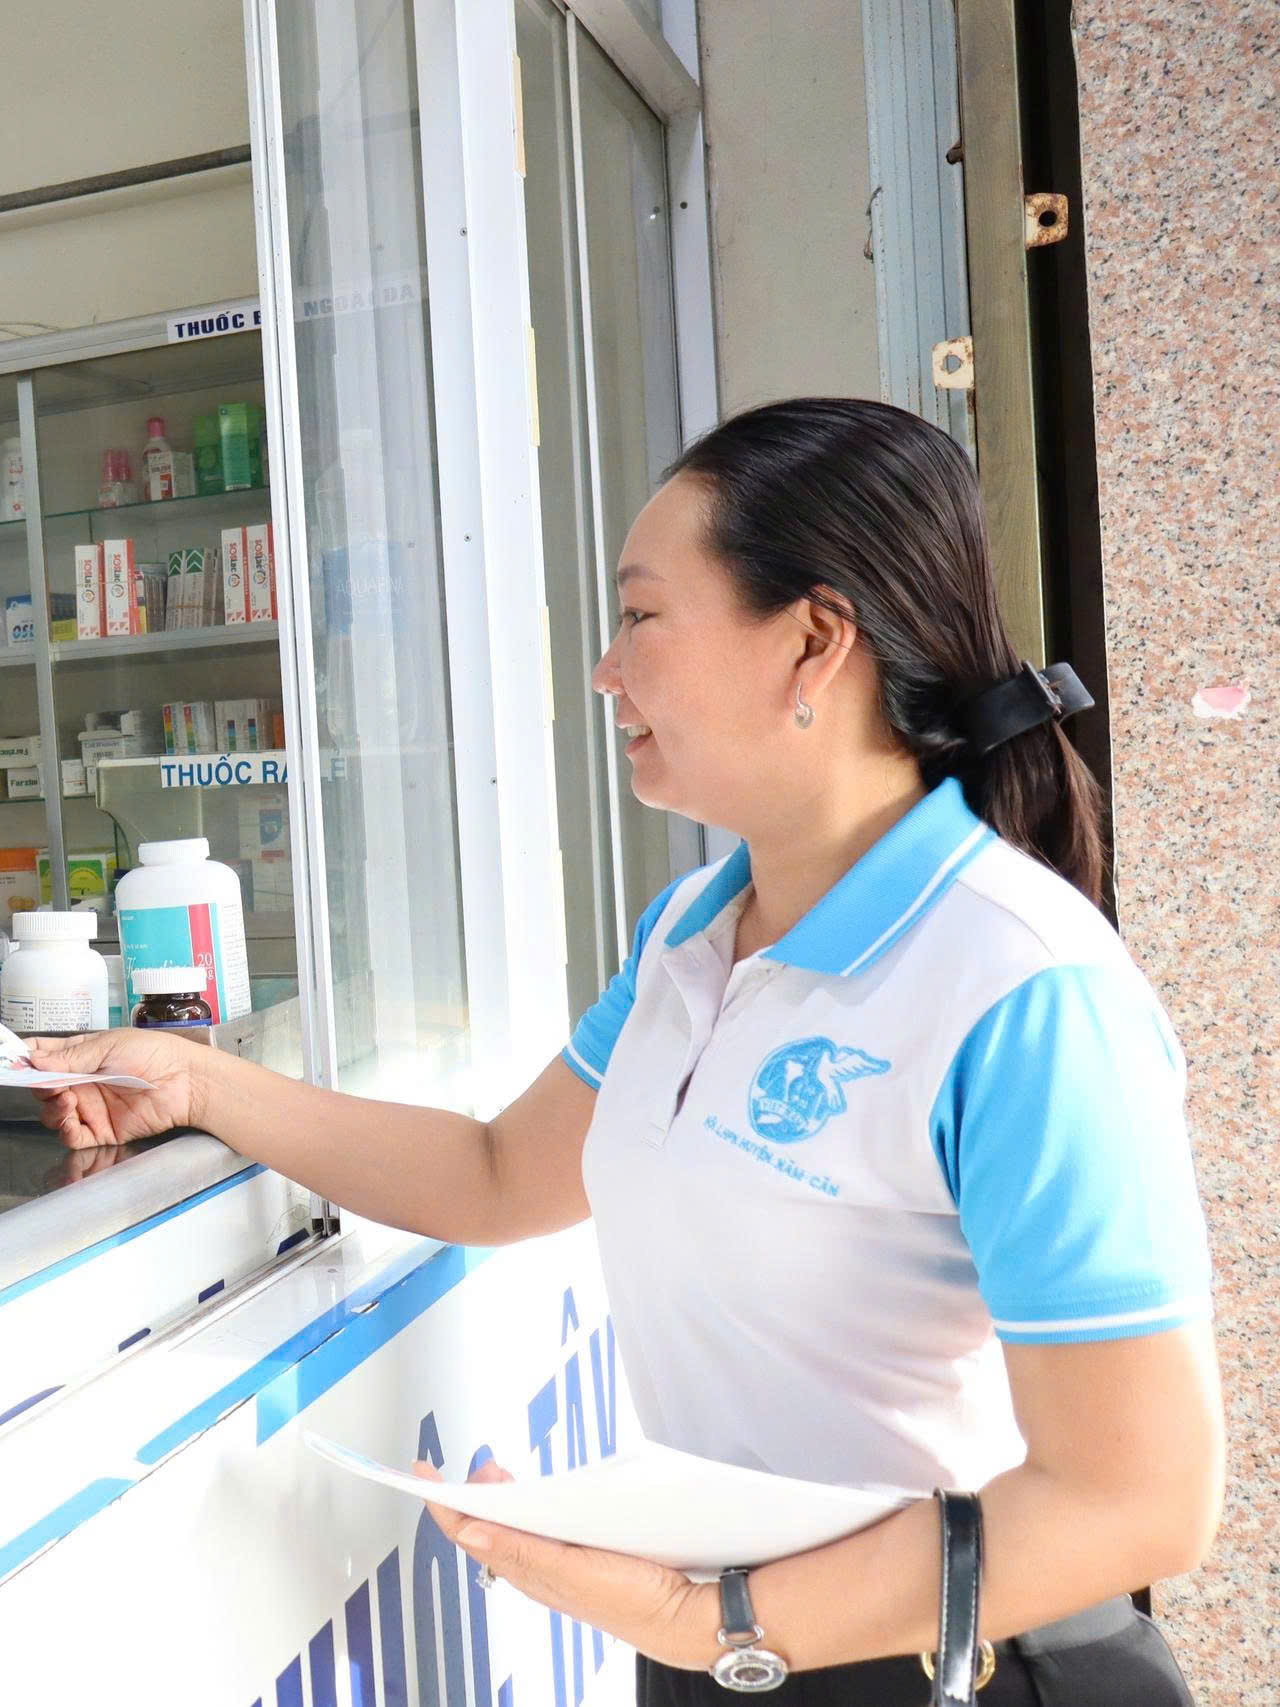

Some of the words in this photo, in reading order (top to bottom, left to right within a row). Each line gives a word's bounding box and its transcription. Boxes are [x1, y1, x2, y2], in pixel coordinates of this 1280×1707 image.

[174, 310, 245, 339] THUỐC
[161, 753, 252, 786] THUỐC
[197, 952, 213, 967] 20
